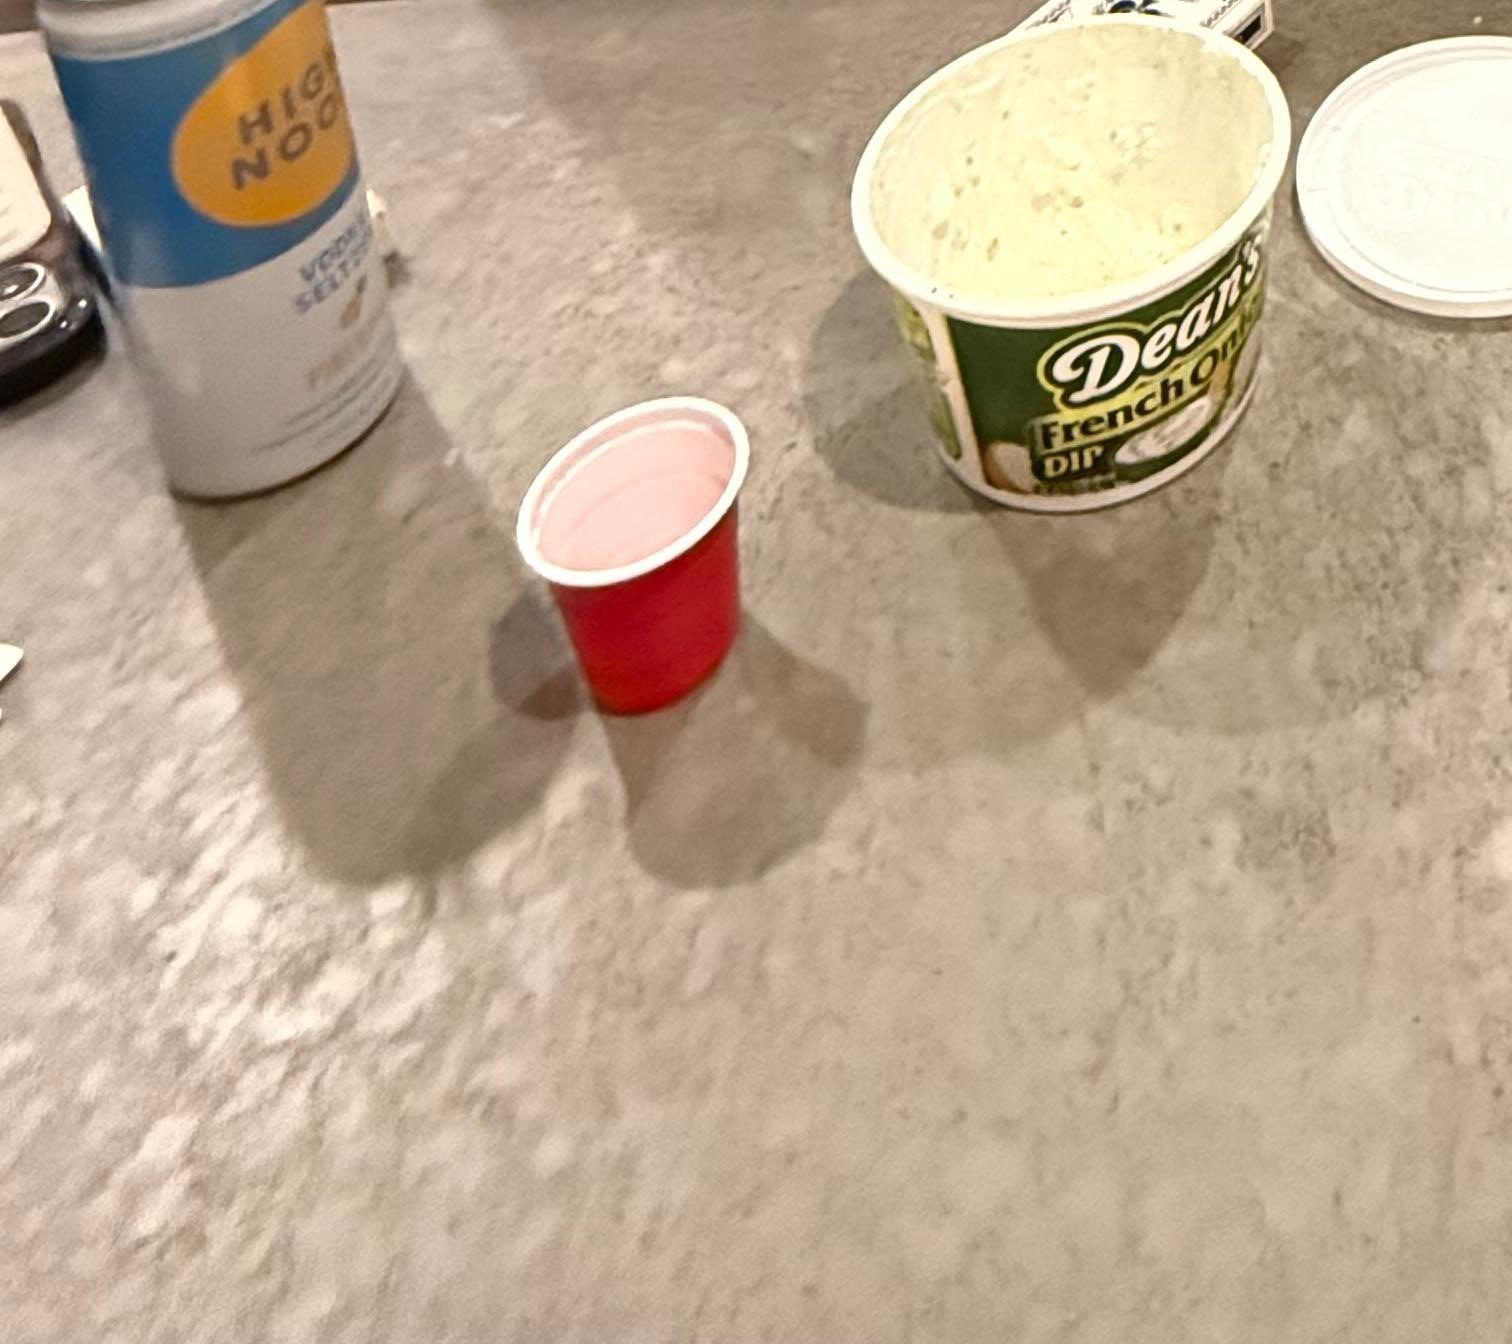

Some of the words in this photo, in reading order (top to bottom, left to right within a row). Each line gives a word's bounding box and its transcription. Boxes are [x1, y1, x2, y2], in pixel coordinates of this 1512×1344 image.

[231, 92, 343, 191] NOO
[1051, 233, 1262, 404] Dean's
[1040, 377, 1184, 450] French
